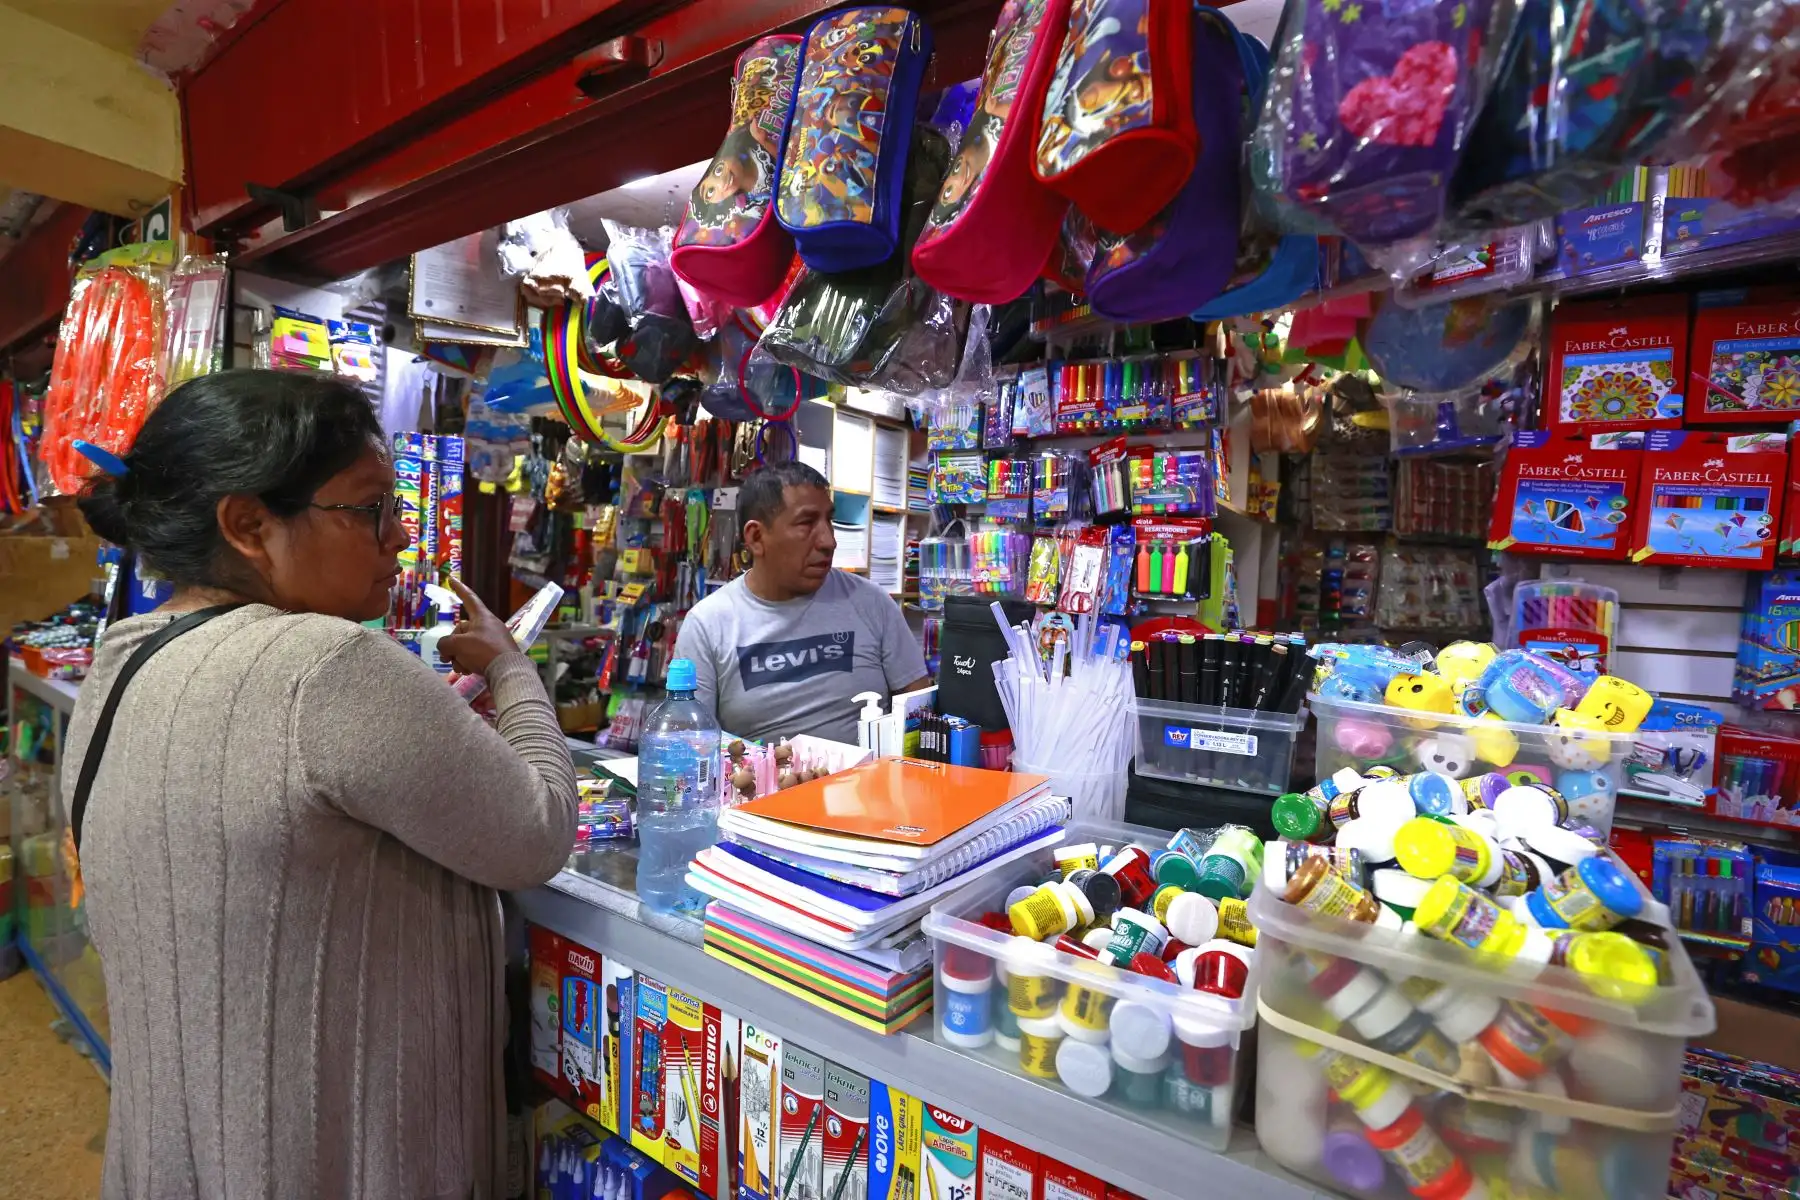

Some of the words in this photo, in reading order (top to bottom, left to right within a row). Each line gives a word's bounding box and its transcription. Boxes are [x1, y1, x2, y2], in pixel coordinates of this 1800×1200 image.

[1583, 207, 1633, 224] ARTESCO
[1564, 335, 1673, 352] FABER-CASTELL
[1518, 463, 1628, 479] FABER-CASTELL
[1654, 468, 1773, 483] FABER-CASTELL
[425, 503, 438, 554] DIVERSIÓN
[1144, 526, 1188, 534] RESALTADORES
[953, 655, 976, 668] Touch
[1675, 711, 1703, 725] Set
[705, 1023, 717, 1091] STABILO
[898, 1108, 907, 1129] GIRLS
[932, 1109, 966, 1130] oval
[756, 1128, 765, 1138] 12
[896, 1131, 905, 1151] LÁPIZ
[932, 1139, 967, 1157] Amarillo
[675, 1162, 682, 1171] 12
[985, 1157, 994, 1166] 12
[948, 1185, 966, 1200] 12
[1047, 1183, 1056, 1193] 12
